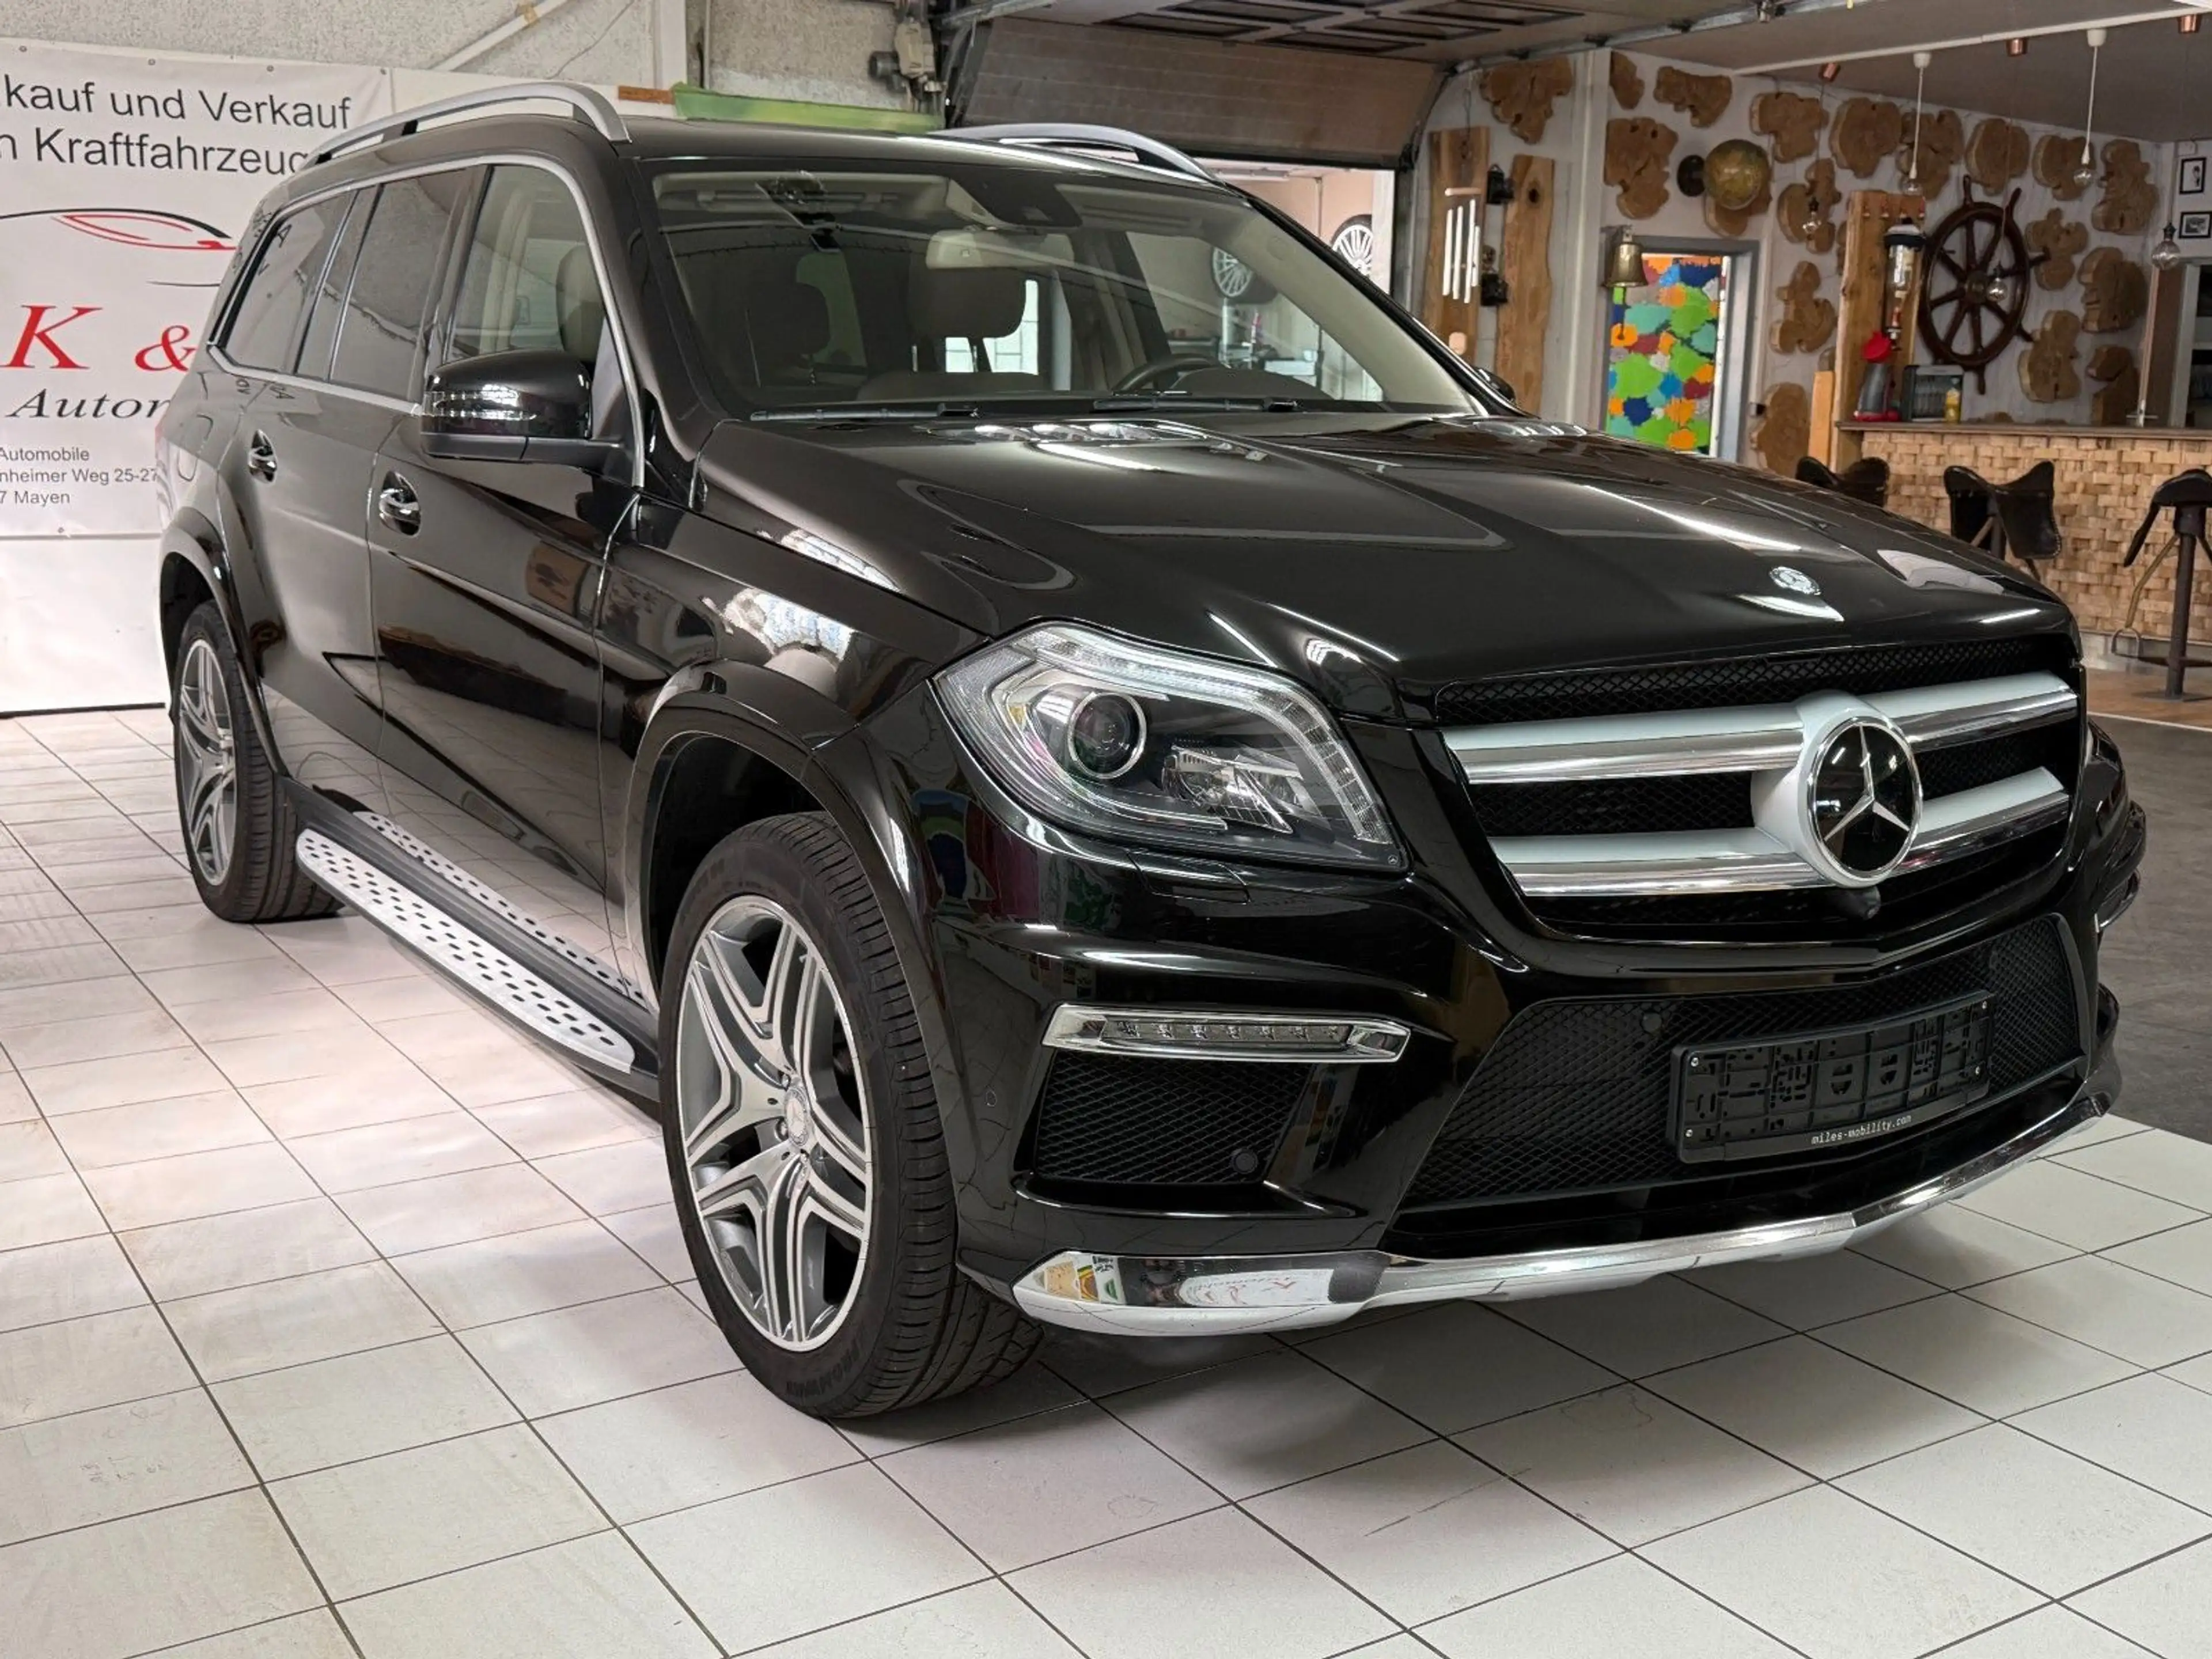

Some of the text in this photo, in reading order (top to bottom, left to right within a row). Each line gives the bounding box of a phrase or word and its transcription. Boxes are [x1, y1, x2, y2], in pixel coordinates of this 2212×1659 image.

[110, 89, 185, 119] und
[198, 90, 351, 129] Verkauf
[0, 304, 197, 372] K &
[72, 469, 109, 486] Weg
[14, 490, 70, 507] Mayen
[1812, 1116, 1912, 1144] miles-mobility.com
